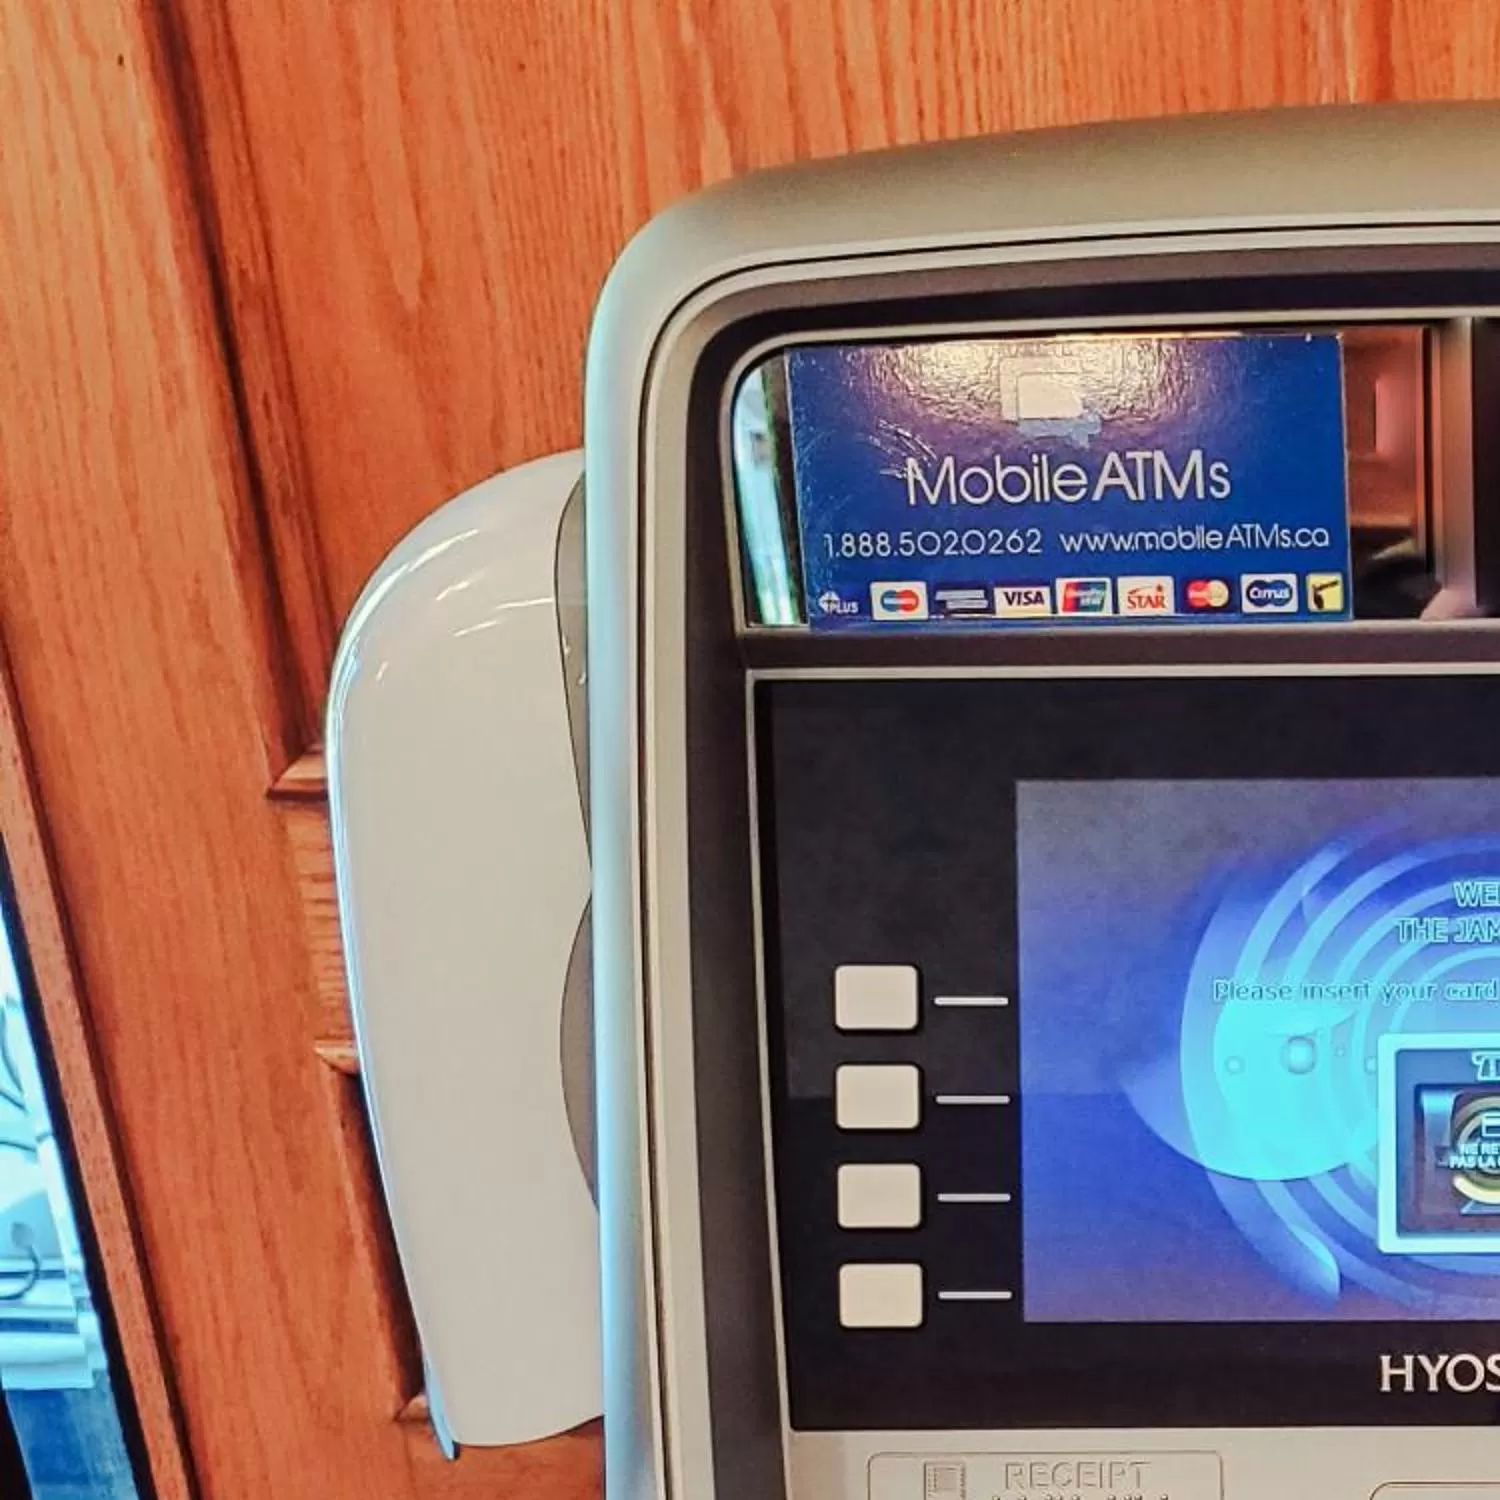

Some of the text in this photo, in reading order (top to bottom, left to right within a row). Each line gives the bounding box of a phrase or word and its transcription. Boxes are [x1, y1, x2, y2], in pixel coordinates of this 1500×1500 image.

[1060, 523, 1330, 551] www.mobileATMs.ca
[1003, 591, 1045, 609] VISA
[1127, 592, 1166, 610] STAR
[1398, 916, 1449, 943] THE
[1213, 979, 1292, 1001] Please
[1302, 979, 1369, 1001] insert
[1381, 983, 1435, 1006] your
[1445, 978, 1497, 1001] card
[1004, 1460, 1152, 1490] RECEIPT
